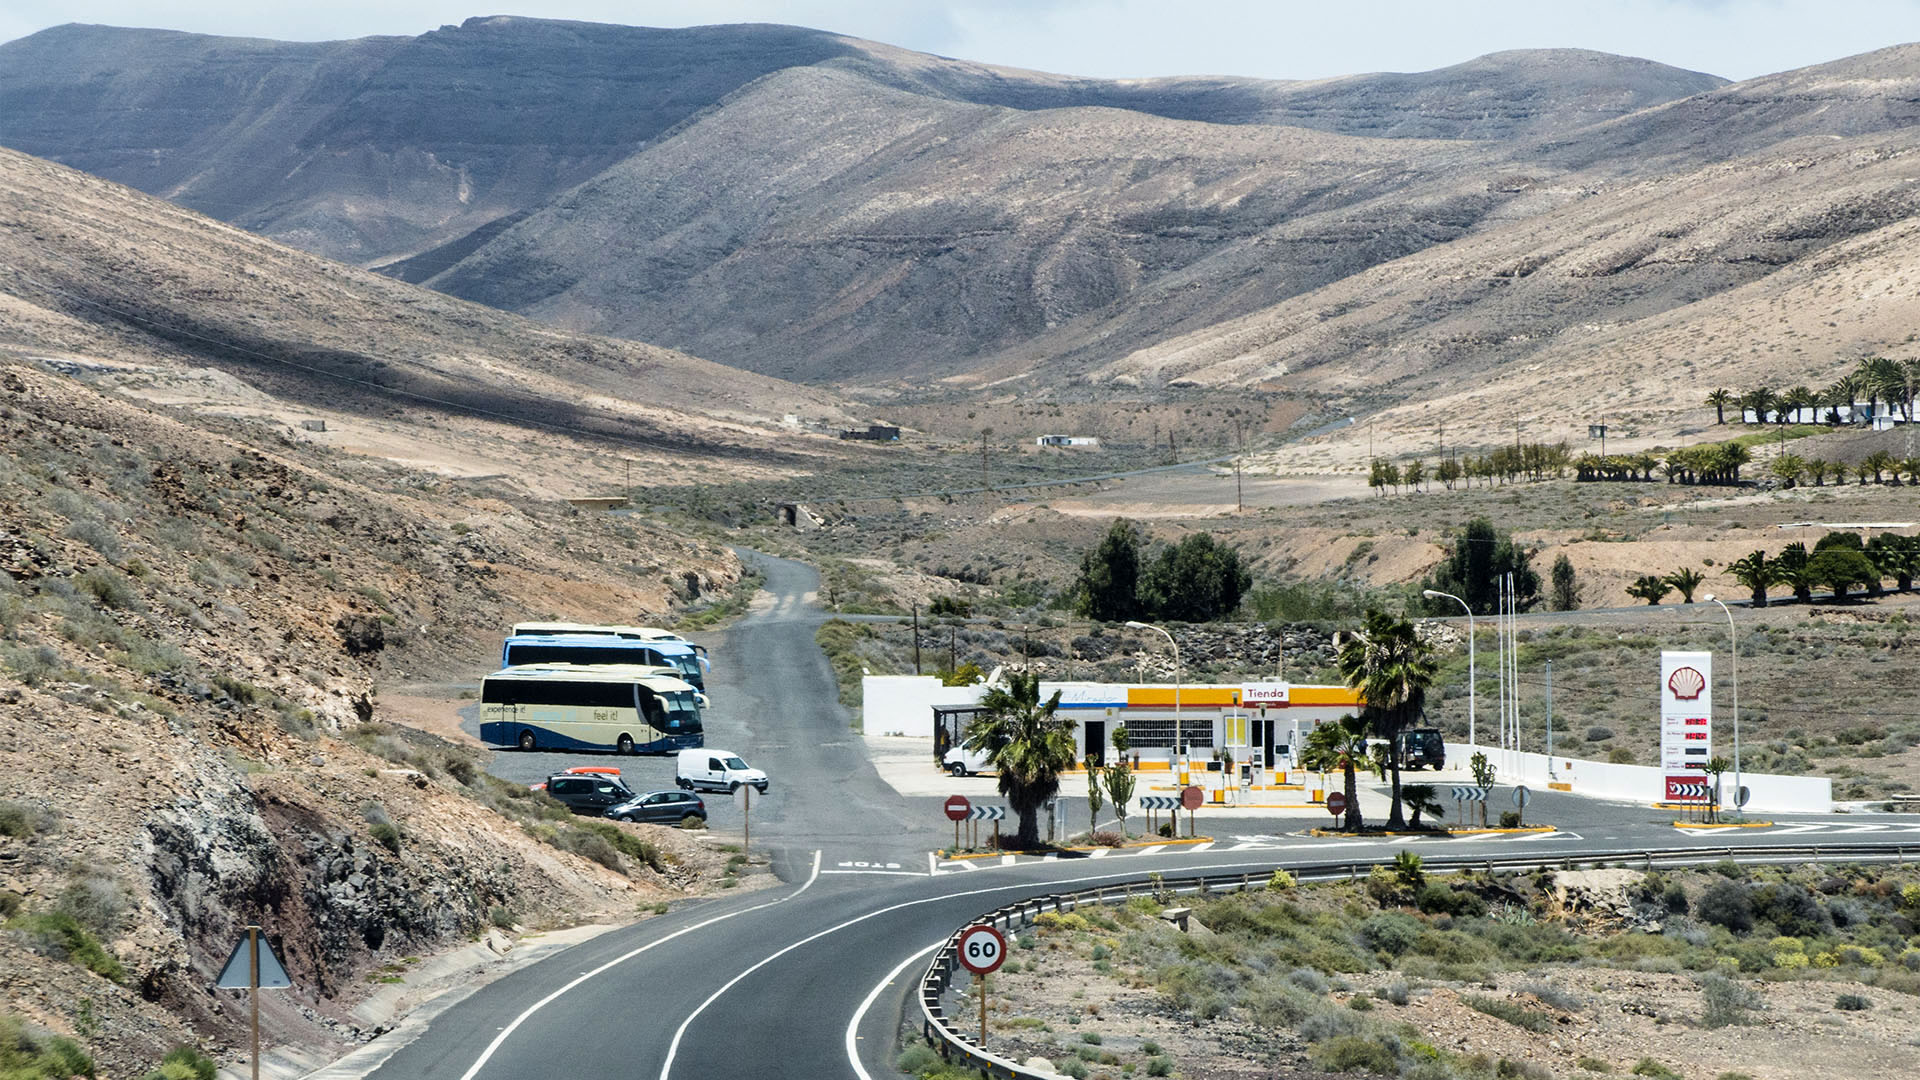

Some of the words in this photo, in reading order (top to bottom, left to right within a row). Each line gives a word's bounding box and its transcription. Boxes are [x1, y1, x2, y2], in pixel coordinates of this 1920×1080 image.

[1248, 689, 1284, 698] Tienda
[593, 709, 608, 721] feel
[610, 710, 618, 721] it!
[838, 861, 901, 869] STOP
[968, 941, 996, 958] 60
